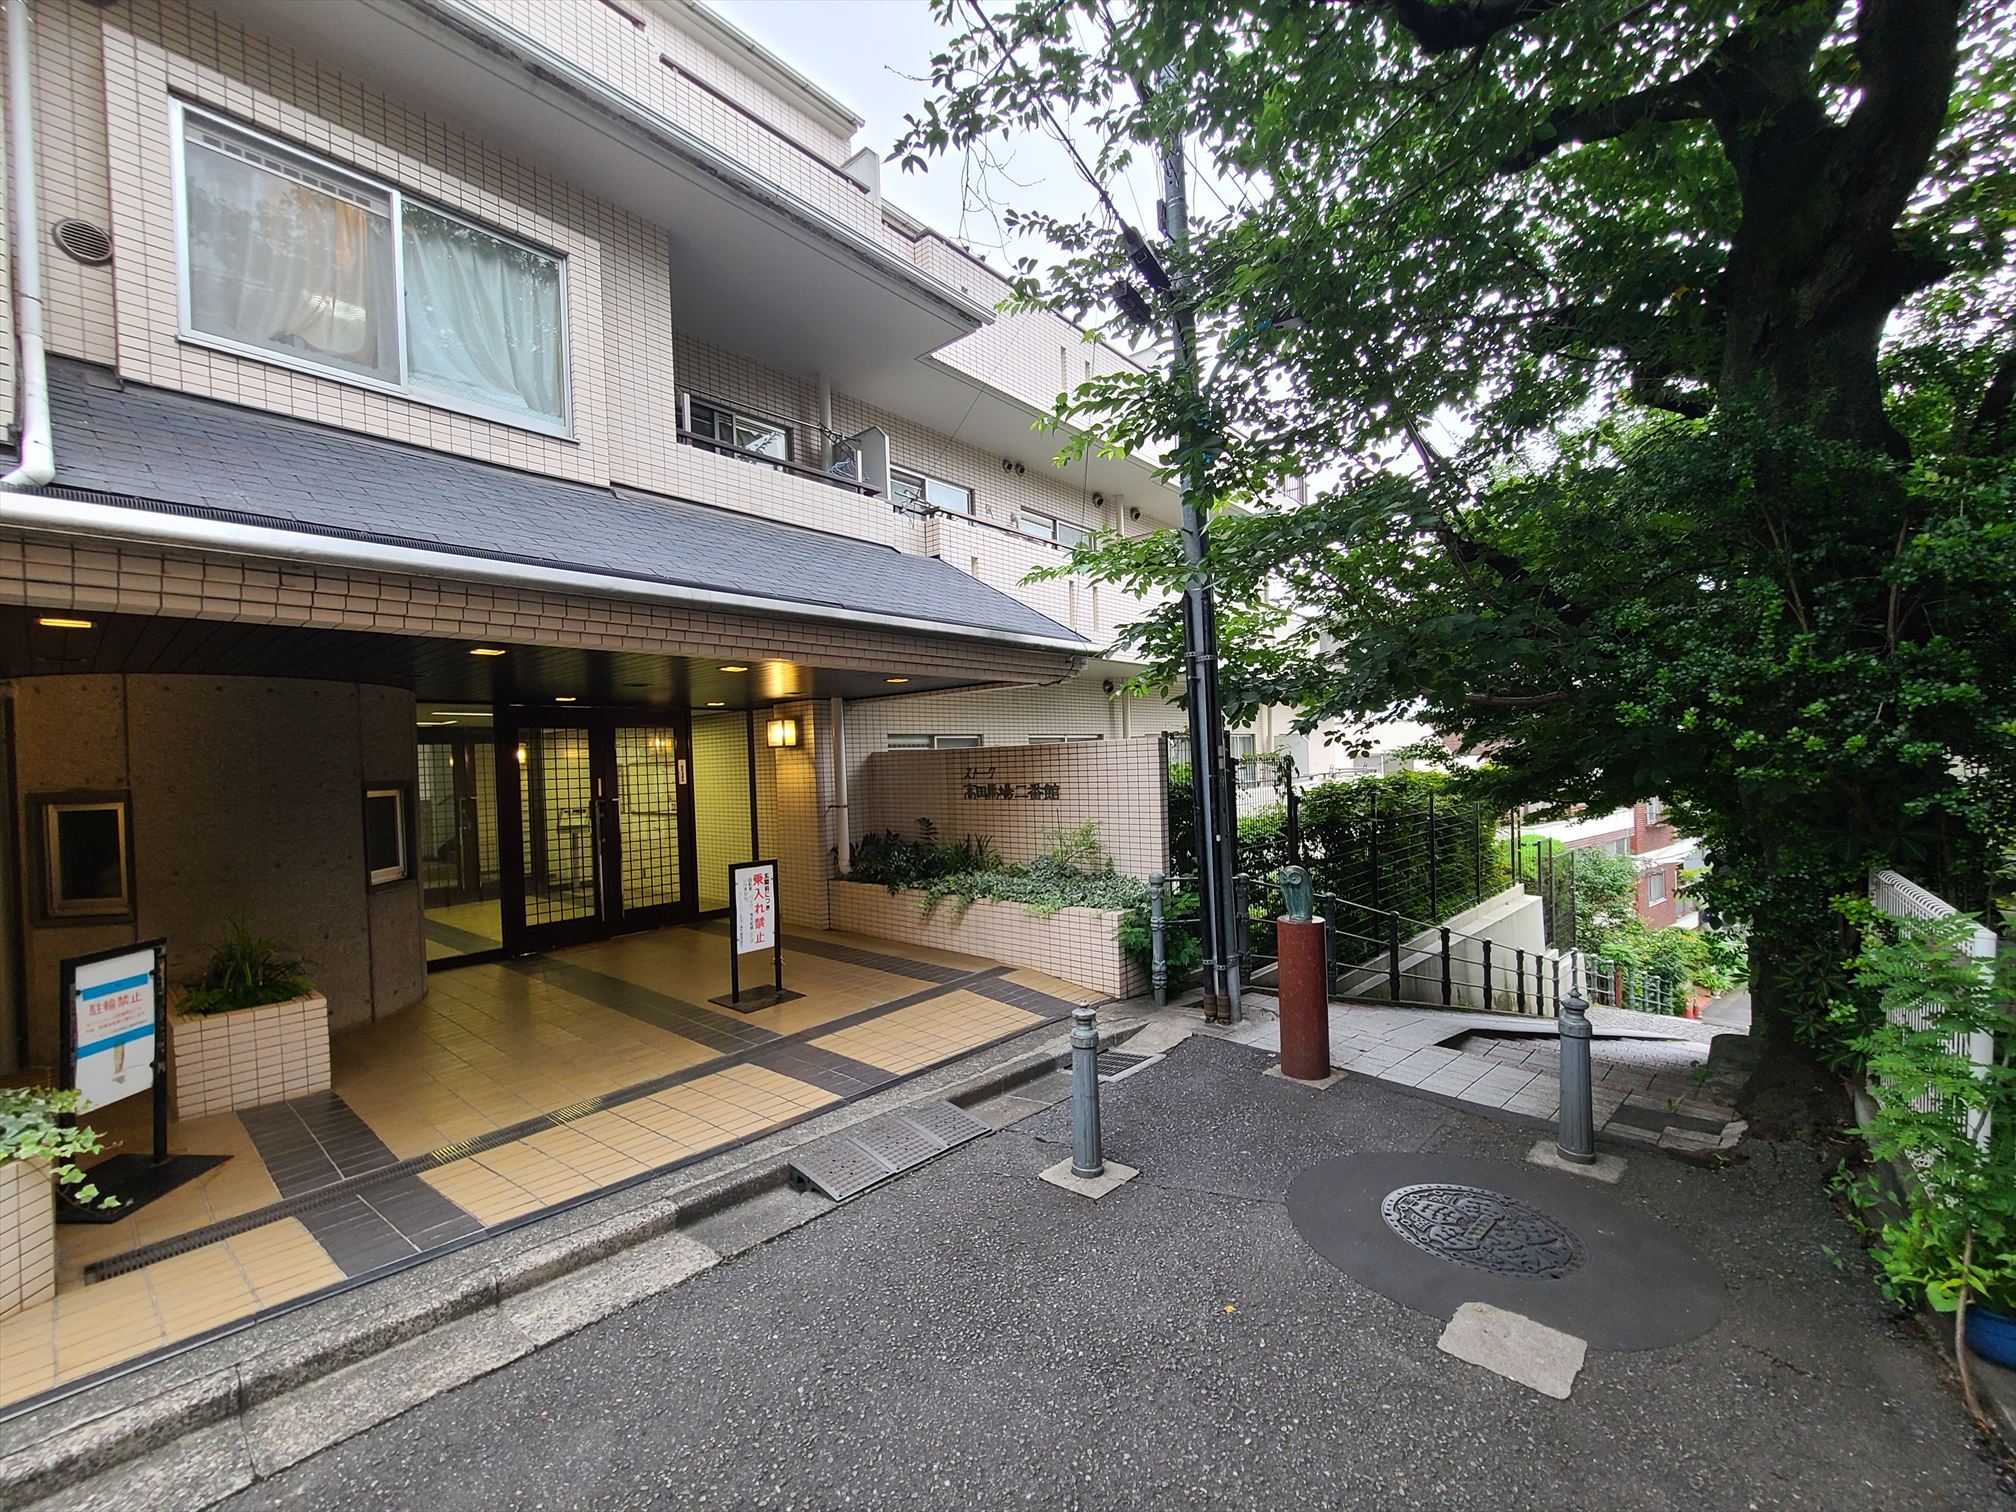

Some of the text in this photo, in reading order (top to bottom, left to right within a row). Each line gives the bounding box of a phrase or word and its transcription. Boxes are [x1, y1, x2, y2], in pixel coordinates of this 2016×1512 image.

[963, 782, 1060, 800] 高田馬場二番館
[753, 873, 765, 944] 乗入れ禁止
[89, 991, 142, 1016] 駐輪禁止
